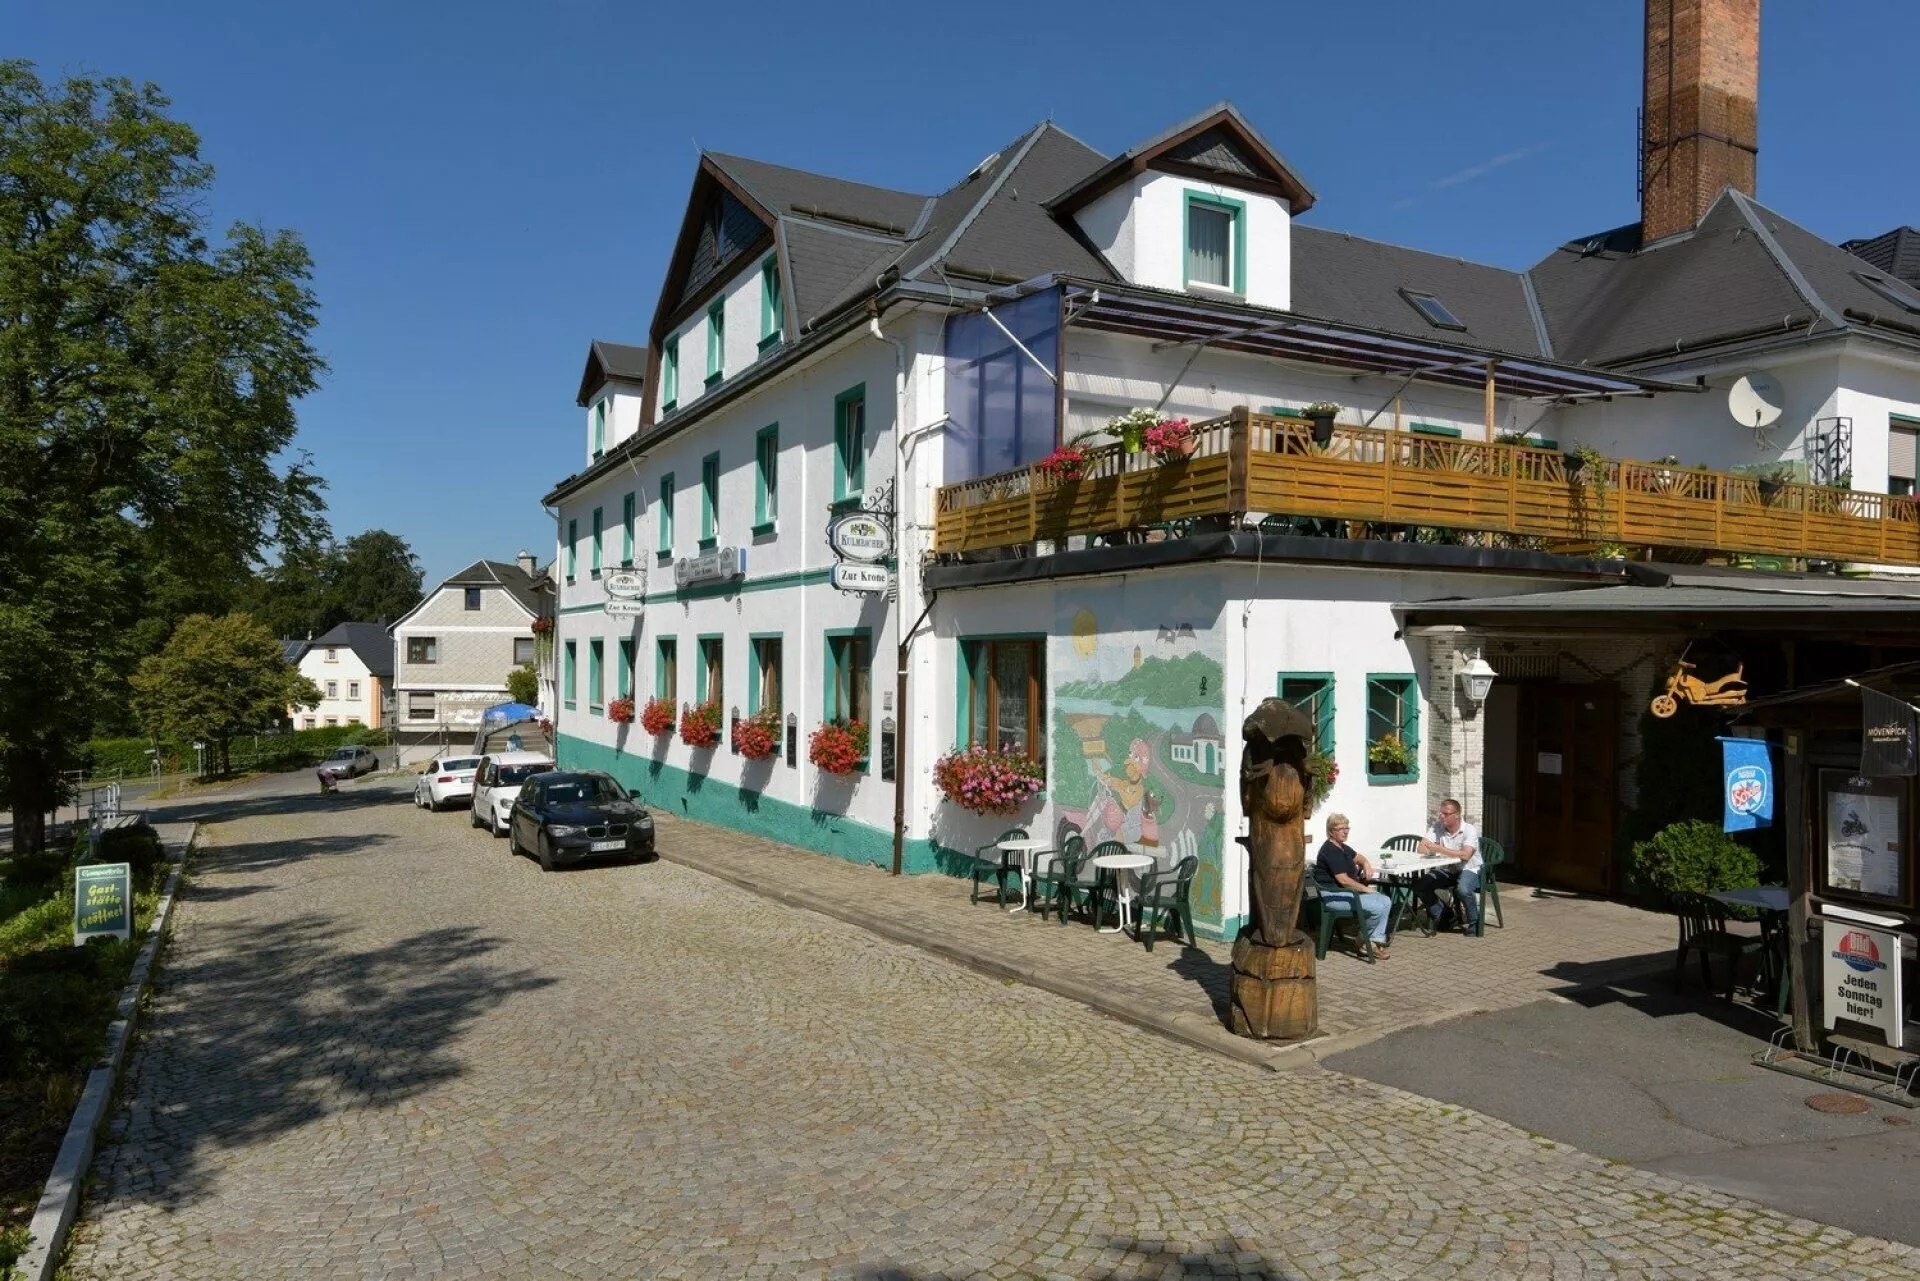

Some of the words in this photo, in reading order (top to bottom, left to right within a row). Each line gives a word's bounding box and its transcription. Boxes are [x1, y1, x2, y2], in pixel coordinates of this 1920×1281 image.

[841, 570, 857, 581] Zur
[860, 571, 886, 582] Krone
[1867, 726, 1907, 737] MÖVENPICK
[1843, 973, 1878, 992] Jeden
[1837, 985, 1883, 1009] Sonntag
[1846, 1001, 1874, 1019] hier!
